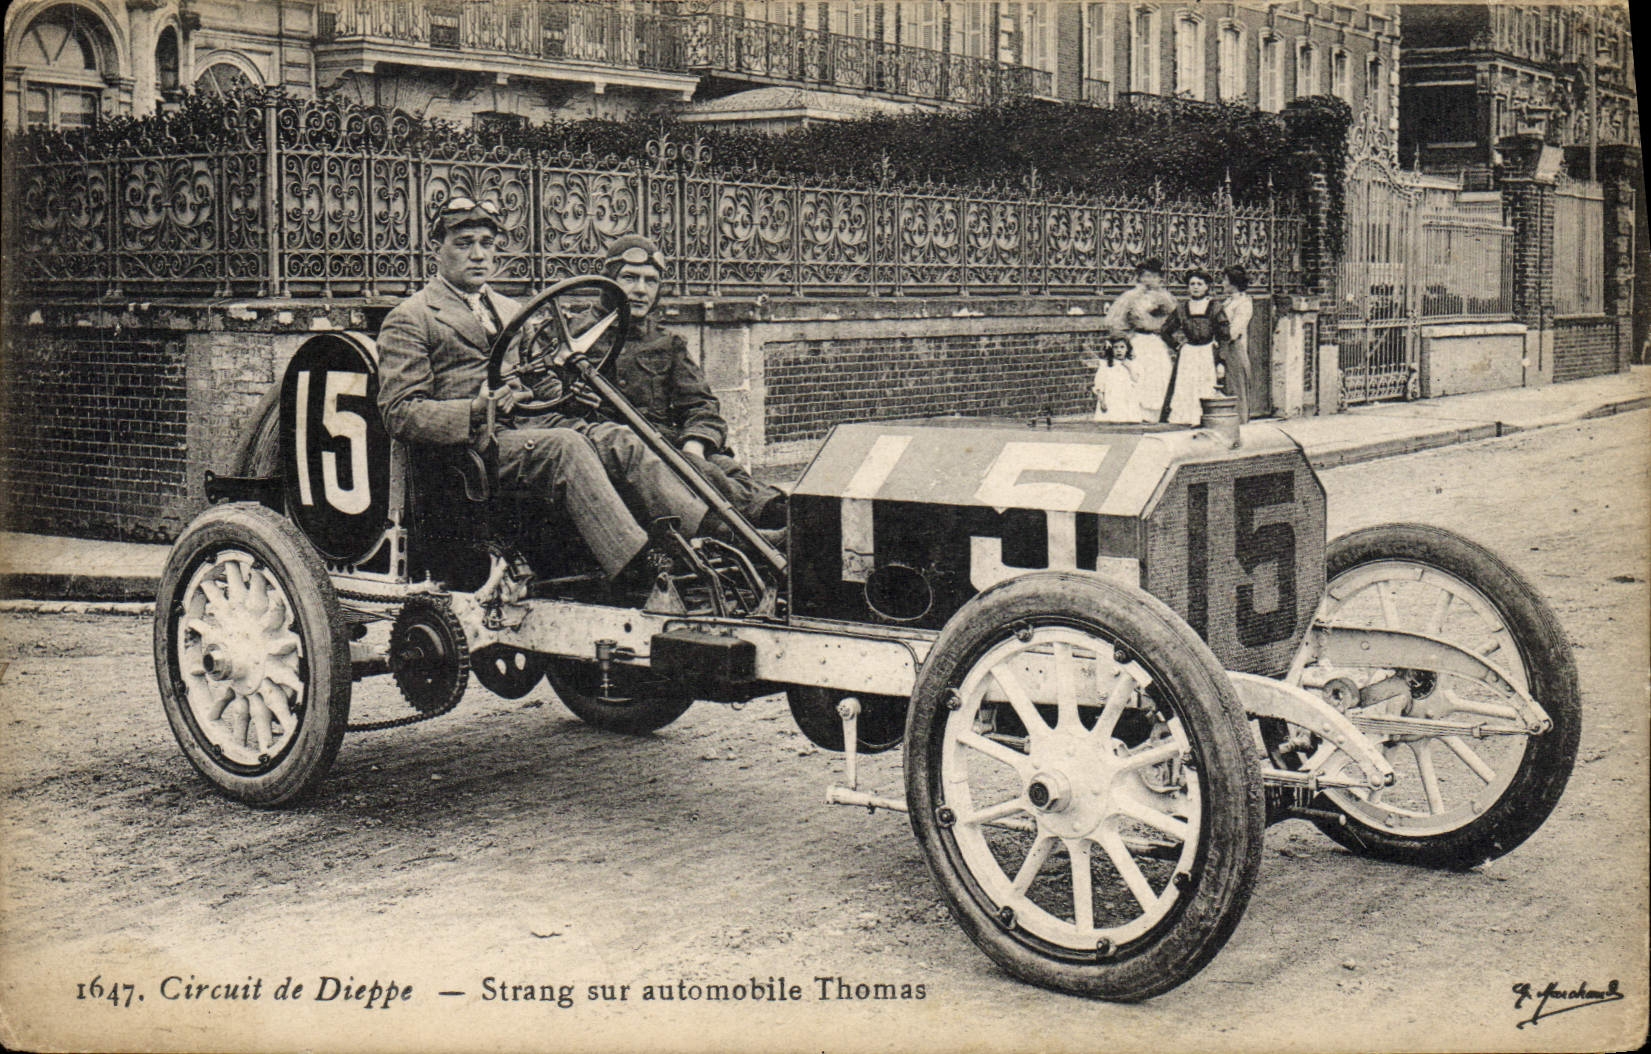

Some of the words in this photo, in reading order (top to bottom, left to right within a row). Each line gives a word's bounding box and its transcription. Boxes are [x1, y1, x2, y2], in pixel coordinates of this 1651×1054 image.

[296, 370, 372, 515] 15
[841, 434, 1110, 592] 15
[1187, 470, 1295, 647] 15
